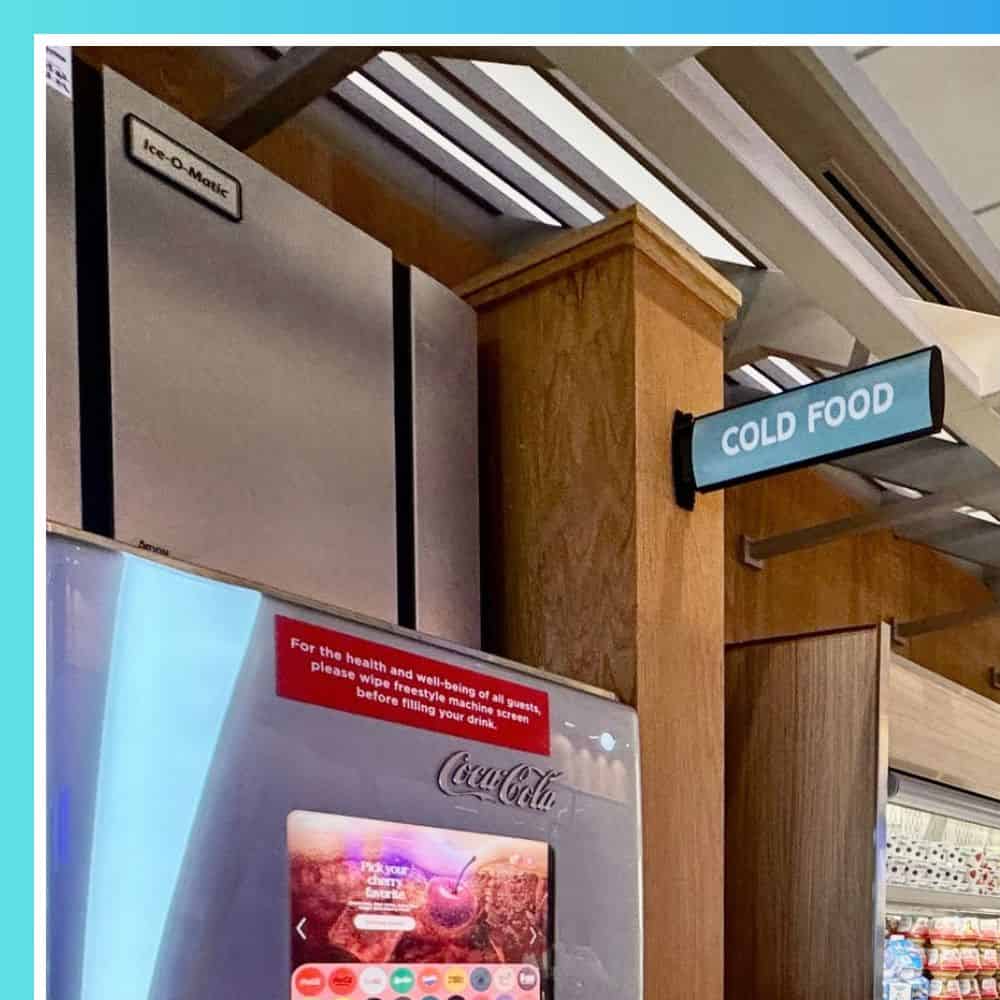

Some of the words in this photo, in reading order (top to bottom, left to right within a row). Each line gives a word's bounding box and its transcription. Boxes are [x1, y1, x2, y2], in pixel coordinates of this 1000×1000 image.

[143, 138, 229, 199] Ice-O-Matic
[721, 410, 797, 457] COLD
[807, 381, 895, 434] FOOD
[290, 637, 316, 654] For
[320, 645, 342, 661] the
[346, 651, 387, 673] health
[390, 668, 413, 680] and
[416, 672, 476, 698] well-being
[478, 688, 490, 700] of
[492, 692, 505, 704] all
[507, 698, 542, 716] guests,
[311, 661, 356, 680] please
[360, 673, 390, 689] wipe
[394, 679, 446, 704] freestyle
[448, 695, 494, 715] machine
[496, 708, 529, 724] screen
[356, 685, 399, 706] before
[402, 697, 436, 717] filling
[439, 707, 465, 722] your
[467, 713, 498, 730] drink.
